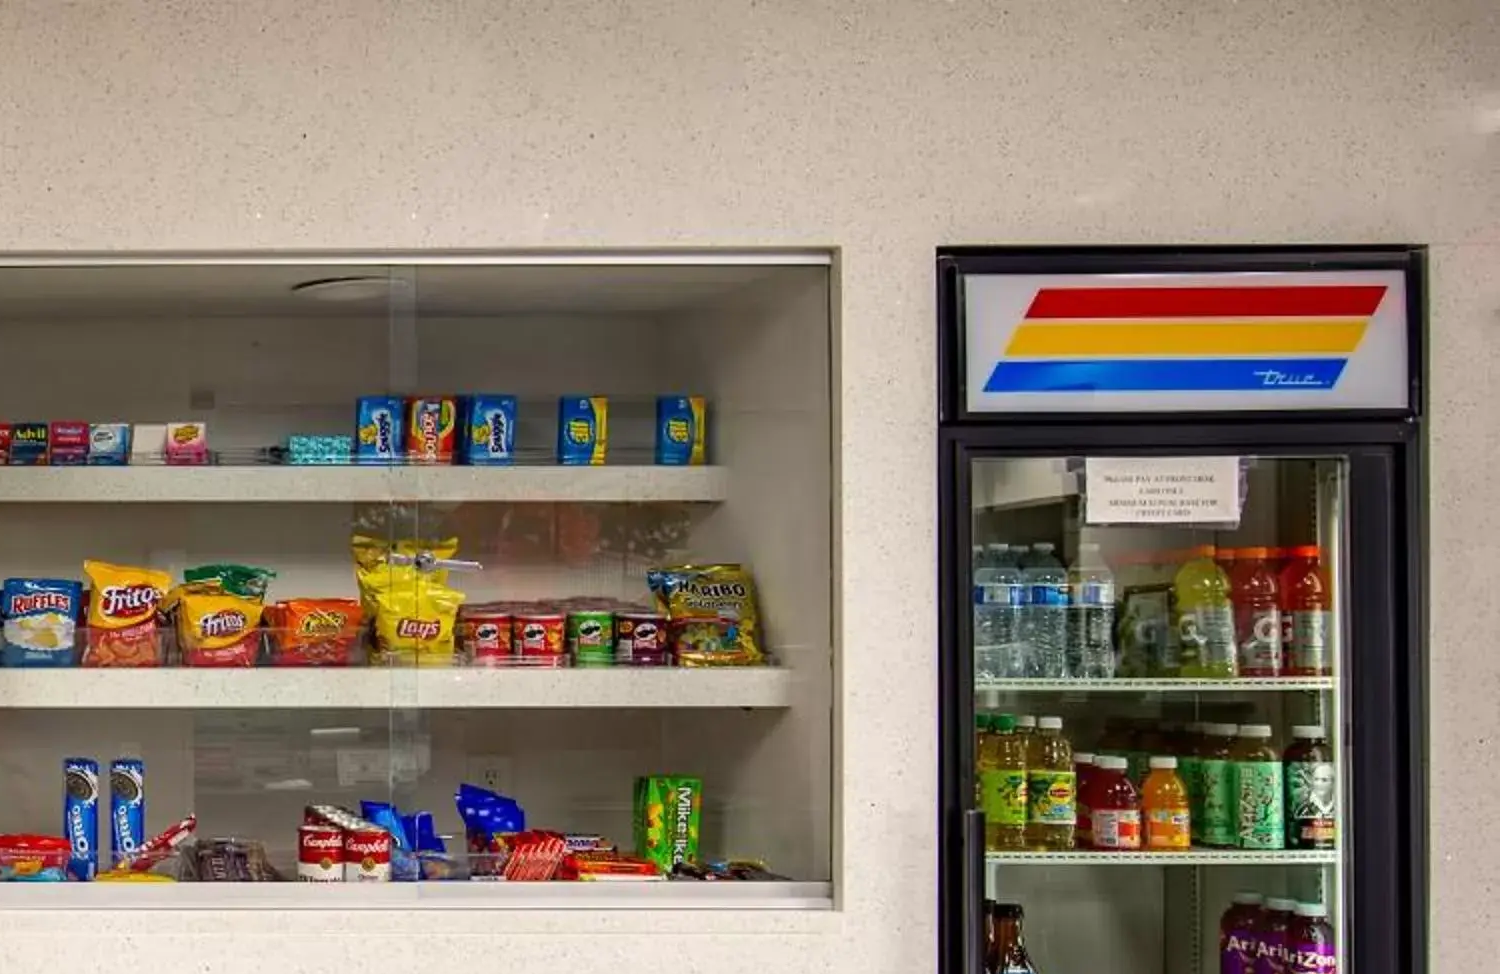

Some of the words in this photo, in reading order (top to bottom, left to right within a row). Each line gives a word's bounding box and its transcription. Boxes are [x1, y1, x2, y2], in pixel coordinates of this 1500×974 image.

[11, 592, 71, 614] RUFFLES
[678, 580, 746, 598] HARIBO
[71, 805, 88, 853] OREO
[117, 805, 135, 853] OREO
[677, 787, 692, 832] Mike
